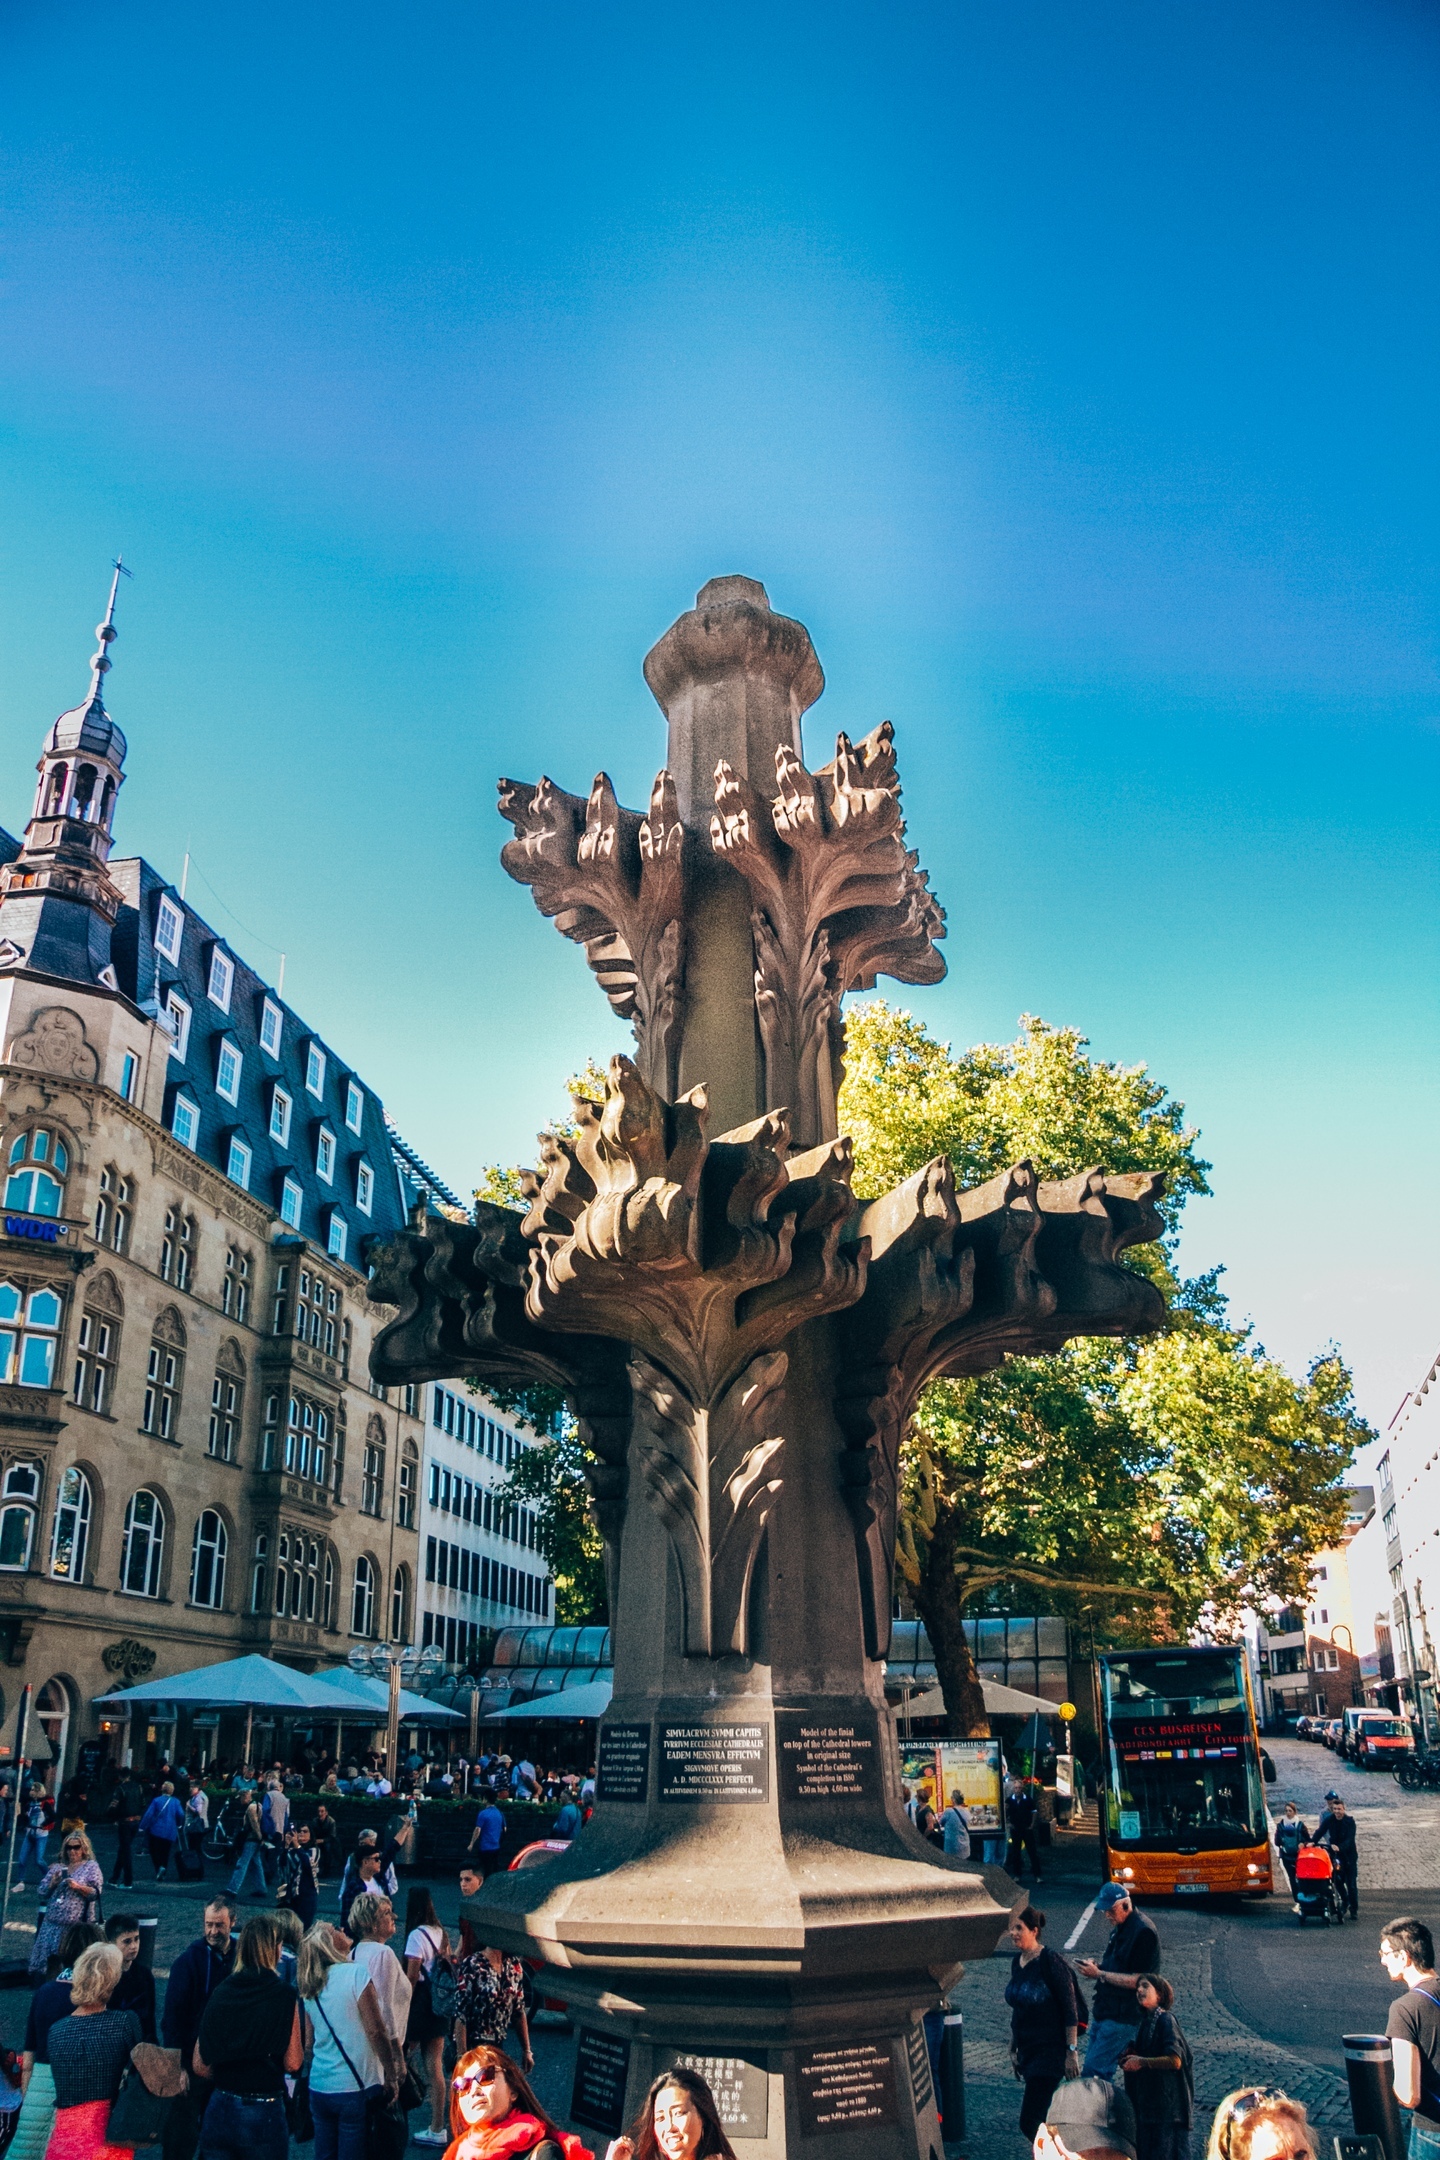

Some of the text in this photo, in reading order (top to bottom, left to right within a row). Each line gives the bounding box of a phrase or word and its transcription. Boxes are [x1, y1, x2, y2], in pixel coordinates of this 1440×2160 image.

[6, 1216, 57, 1242] WDR
[666, 1728, 761, 1738] SIMVLACRVM SVMMI CAPITIS
[801, 1728, 819, 1736] Model
[821, 1728, 827, 1736] of
[839, 1728, 854, 1736] finial
[1134, 1724, 1221, 1736] CCS BUSREISEN
[793, 1741, 802, 1750] top
[822, 1739, 850, 1748] Cathedral
[667, 1750, 760, 1759] EADEM MENSVRA EFFICTVM
[807, 1751, 851, 1761] in original size
[797, 1764, 816, 1773] Symbol
[807, 1775, 835, 1783] completion
[817, 1786, 829, 1794] high
[740, 2113, 748, 2123] 米
